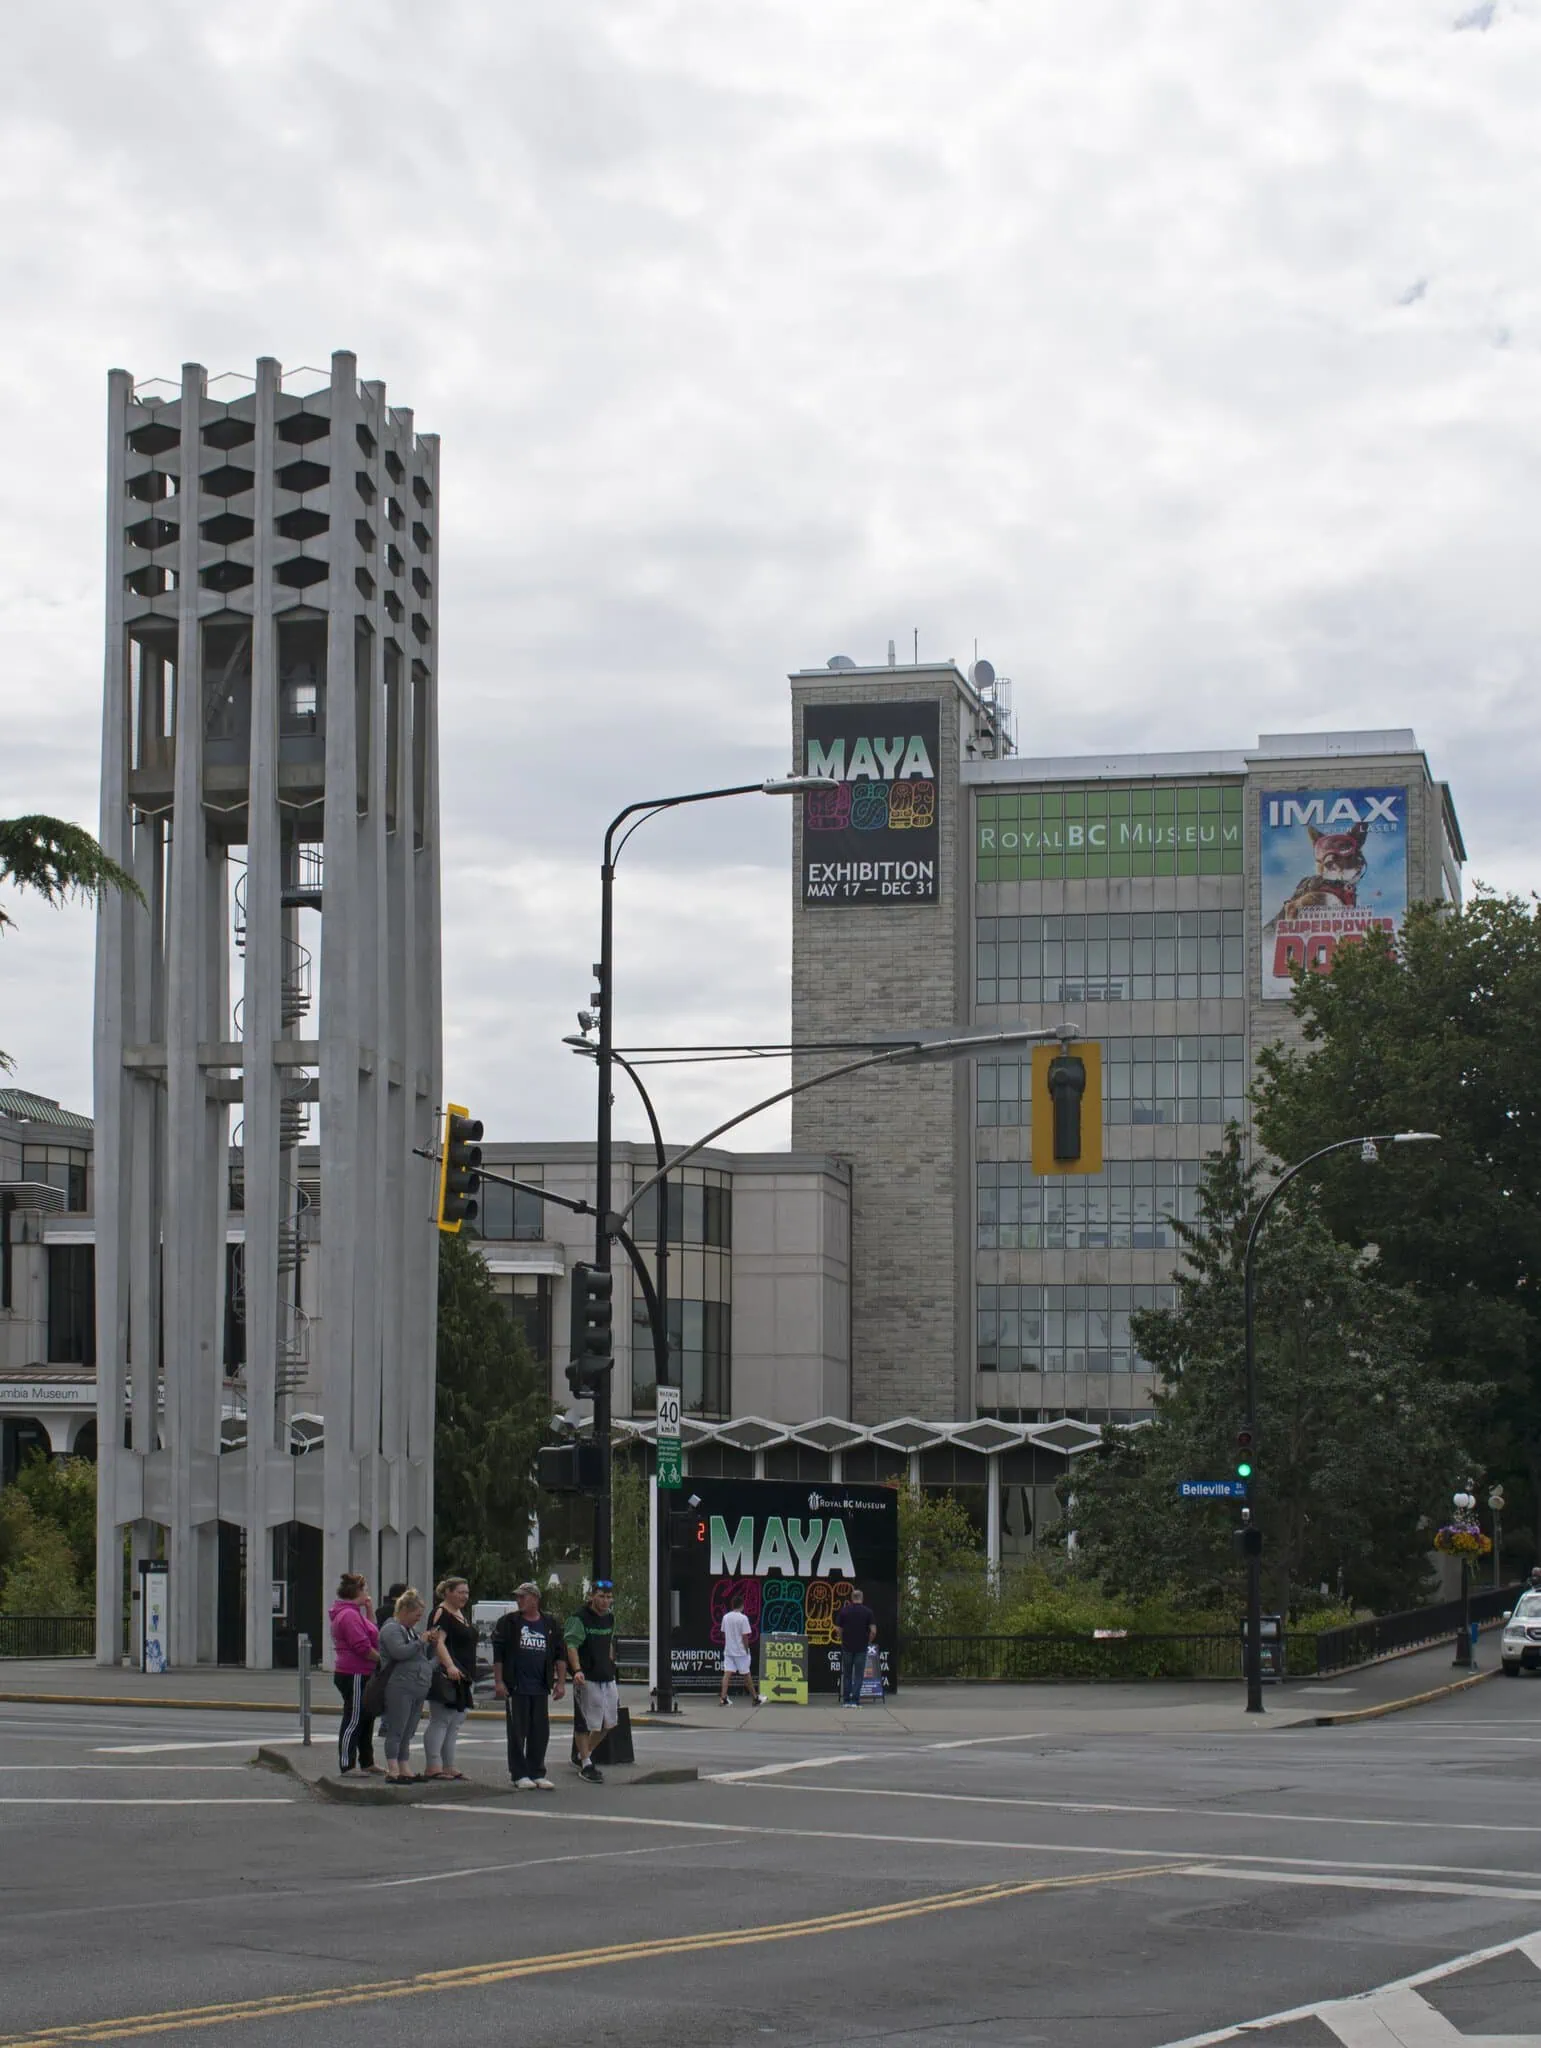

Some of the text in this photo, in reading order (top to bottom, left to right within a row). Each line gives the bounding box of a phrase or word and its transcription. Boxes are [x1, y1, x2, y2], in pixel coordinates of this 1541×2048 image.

[808, 736, 935, 781] MAYA
[1269, 796, 1400, 826] IMAX
[1069, 824, 1106, 846] BC
[1120, 823, 1238, 844] MUSEUM
[808, 861, 933, 882] EXHIBITION
[808, 884, 837, 897] MAY
[843, 884, 860, 896] 17
[881, 882, 911, 896] DEC
[916, 881, 933, 895] 31
[32, 1388, 78, 1399] Museum
[660, 1402, 678, 1423] 40
[1182, 1484, 1231, 1495] Belleville
[709, 1515, 856, 1578] MAYA
[671, 1650, 720, 1660] EXHIBITION
[765, 1642, 804, 1652] FOOD
[671, 1661, 688, 1671] MAY
[692, 1661, 702, 1671] 17
